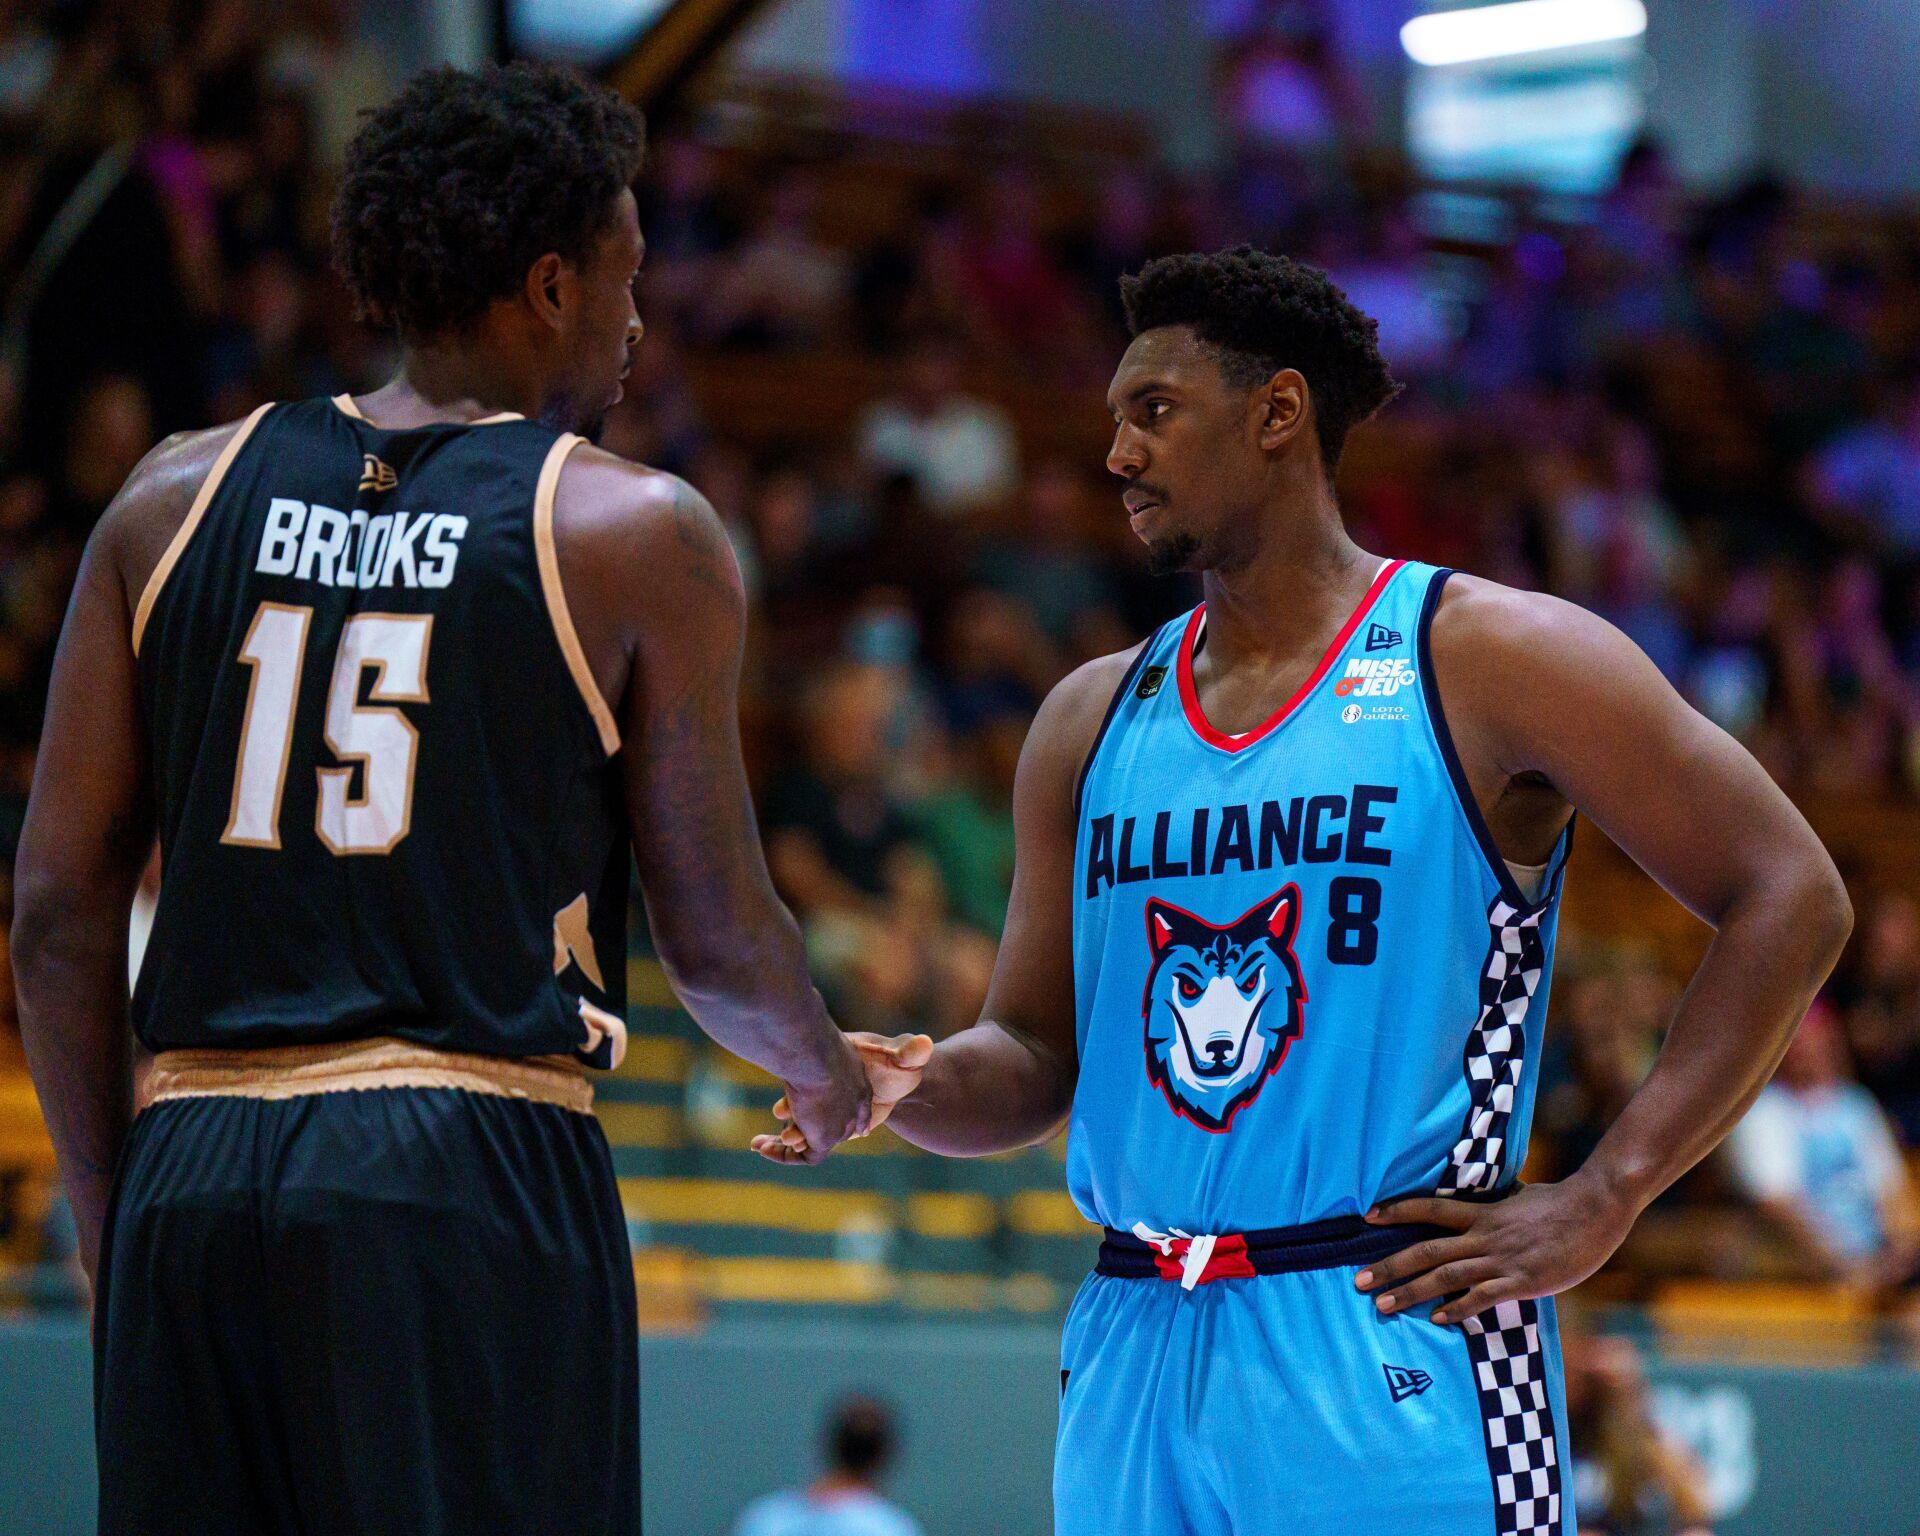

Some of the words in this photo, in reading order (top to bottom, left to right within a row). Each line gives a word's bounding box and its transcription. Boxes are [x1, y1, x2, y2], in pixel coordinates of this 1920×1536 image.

[256, 497, 468, 589] BROOKS
[1344, 658, 1410, 678] MISE
[219, 601, 434, 856] 15
[1362, 712, 1410, 720] QUÉBEC
[1087, 784, 1398, 900] ALLIANCE
[1327, 876, 1382, 966] 8
